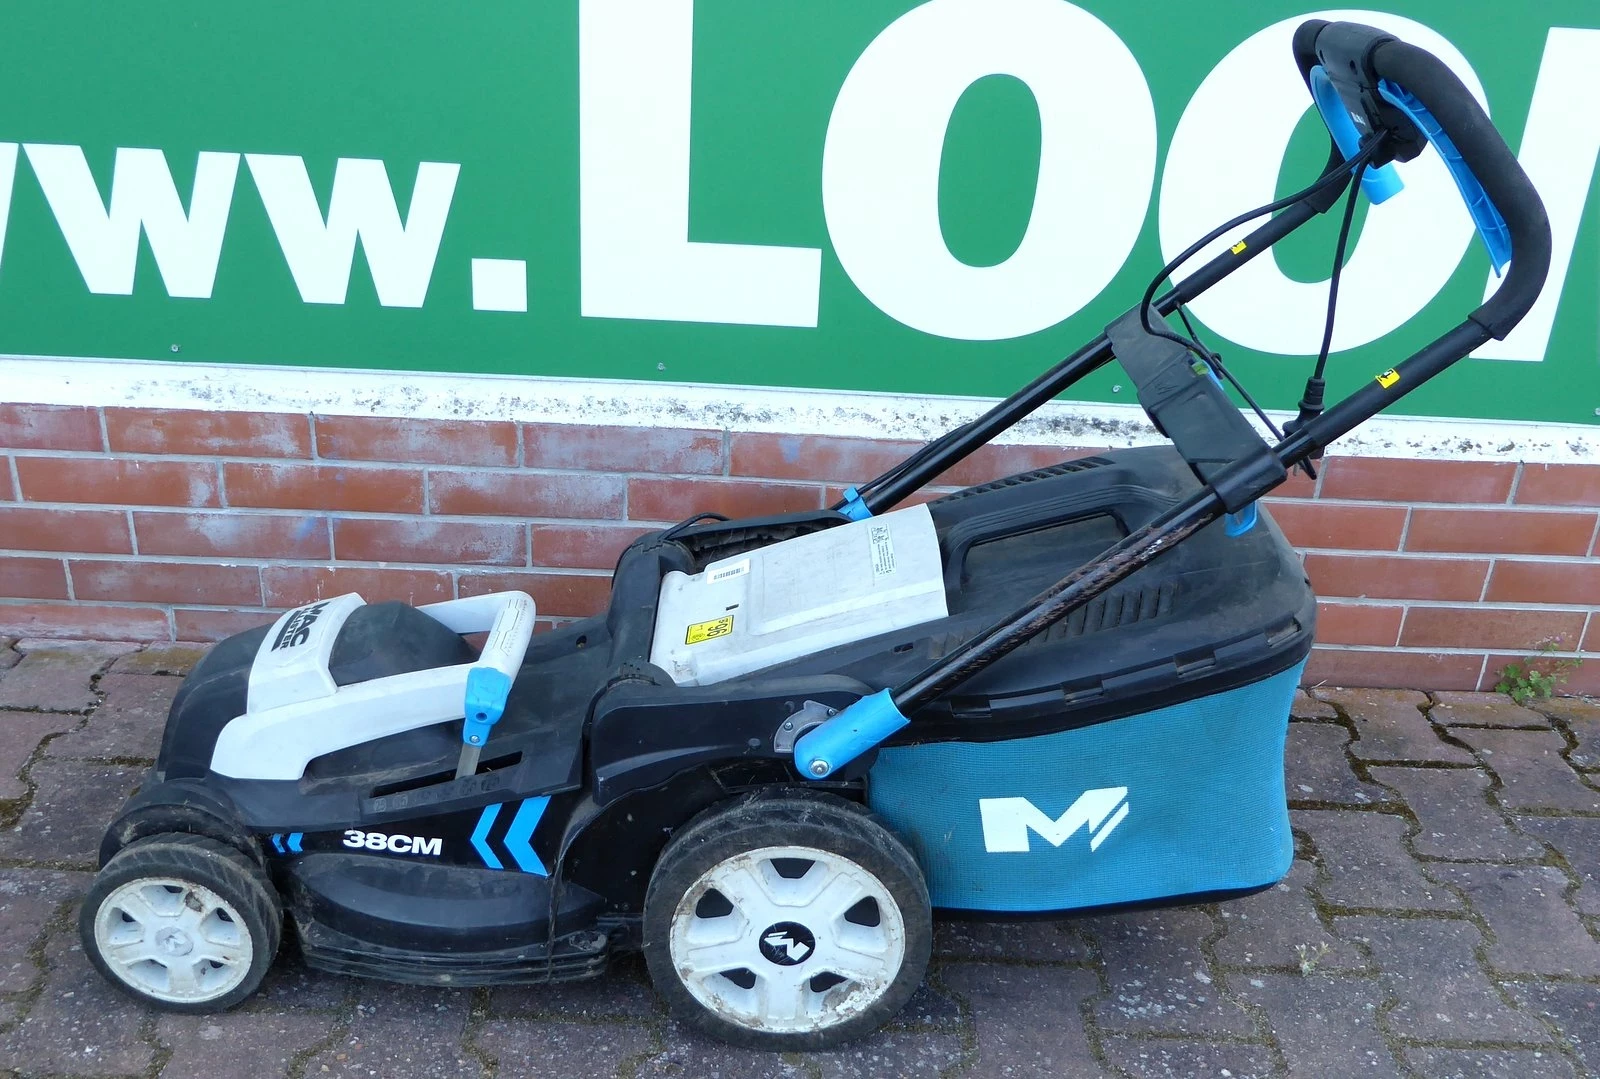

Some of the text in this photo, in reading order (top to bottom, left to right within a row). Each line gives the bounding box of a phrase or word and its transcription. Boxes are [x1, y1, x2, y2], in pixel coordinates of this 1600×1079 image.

[0, 0, 1600, 363] ww.Loo
[290, 601, 331, 648] MAC
[343, 829, 443, 856] 38CM
